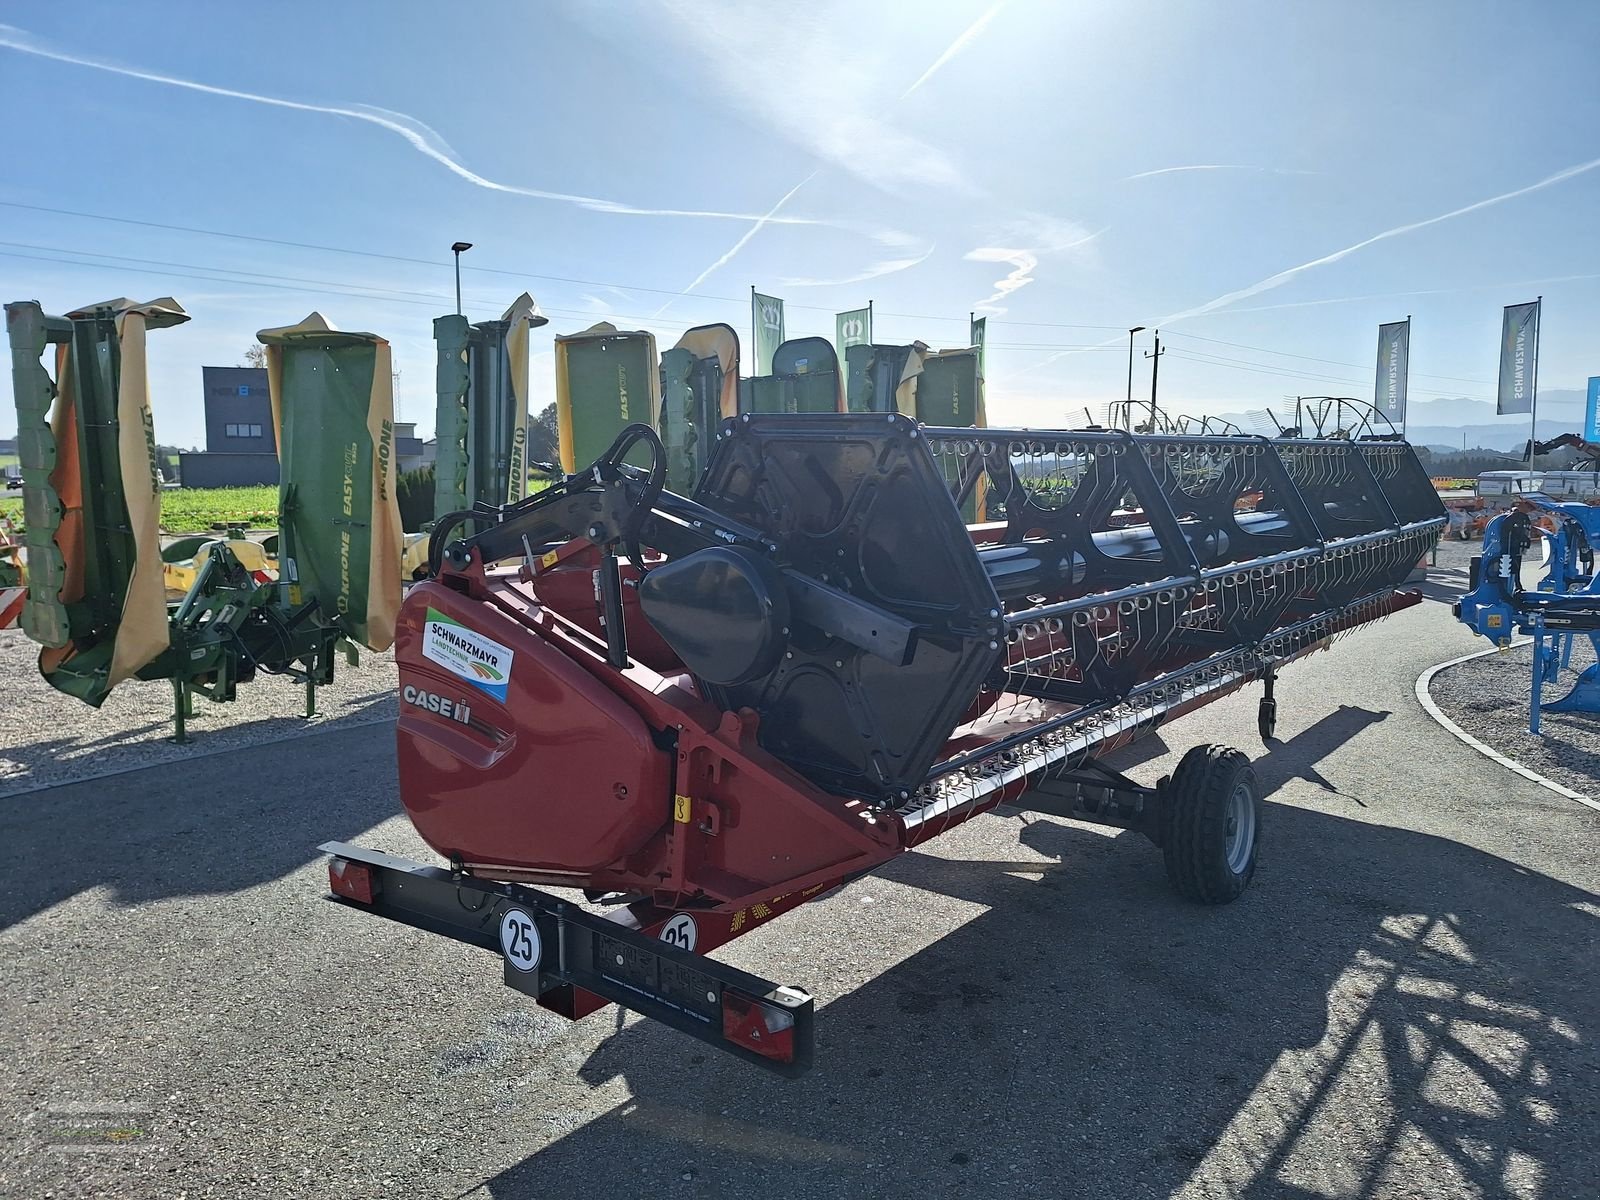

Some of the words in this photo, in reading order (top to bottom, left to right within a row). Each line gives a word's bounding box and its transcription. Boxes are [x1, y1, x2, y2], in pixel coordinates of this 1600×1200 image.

[510, 445, 522, 502] KRONE
[341, 531, 350, 595] KRONE
[431, 623, 498, 667] SCHWARZMAYR
[432, 637, 468, 662] LANDTECHNIK
[403, 685, 452, 717] CASE
[802, 883, 823, 896] Transport
[509, 919, 532, 961] 25
